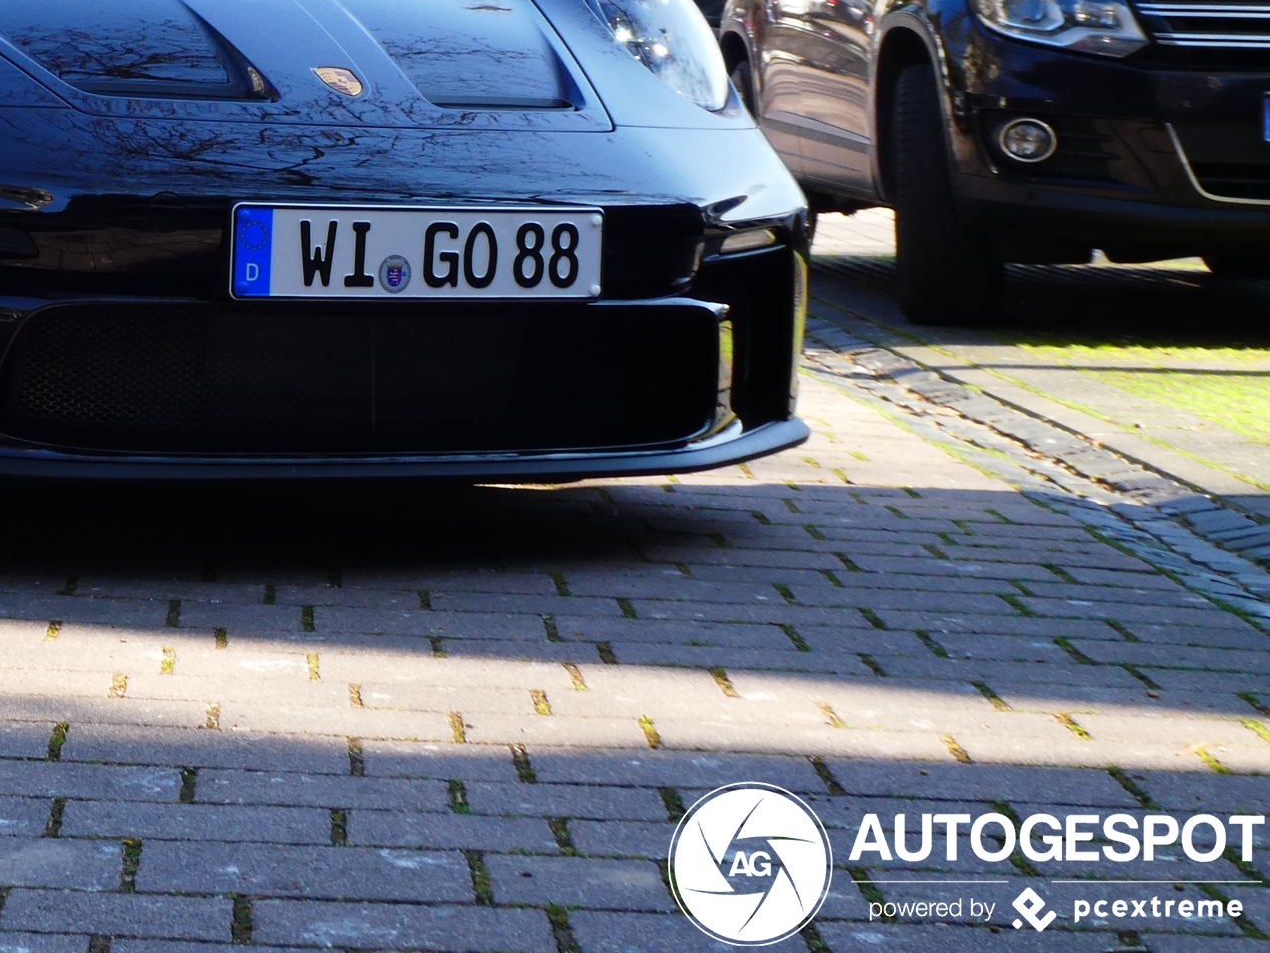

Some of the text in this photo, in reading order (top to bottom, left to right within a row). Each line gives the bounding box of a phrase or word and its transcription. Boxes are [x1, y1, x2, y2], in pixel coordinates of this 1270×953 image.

[246, 263, 259, 282] D
[299, 219, 375, 288] WI
[512, 222, 580, 289] 88
